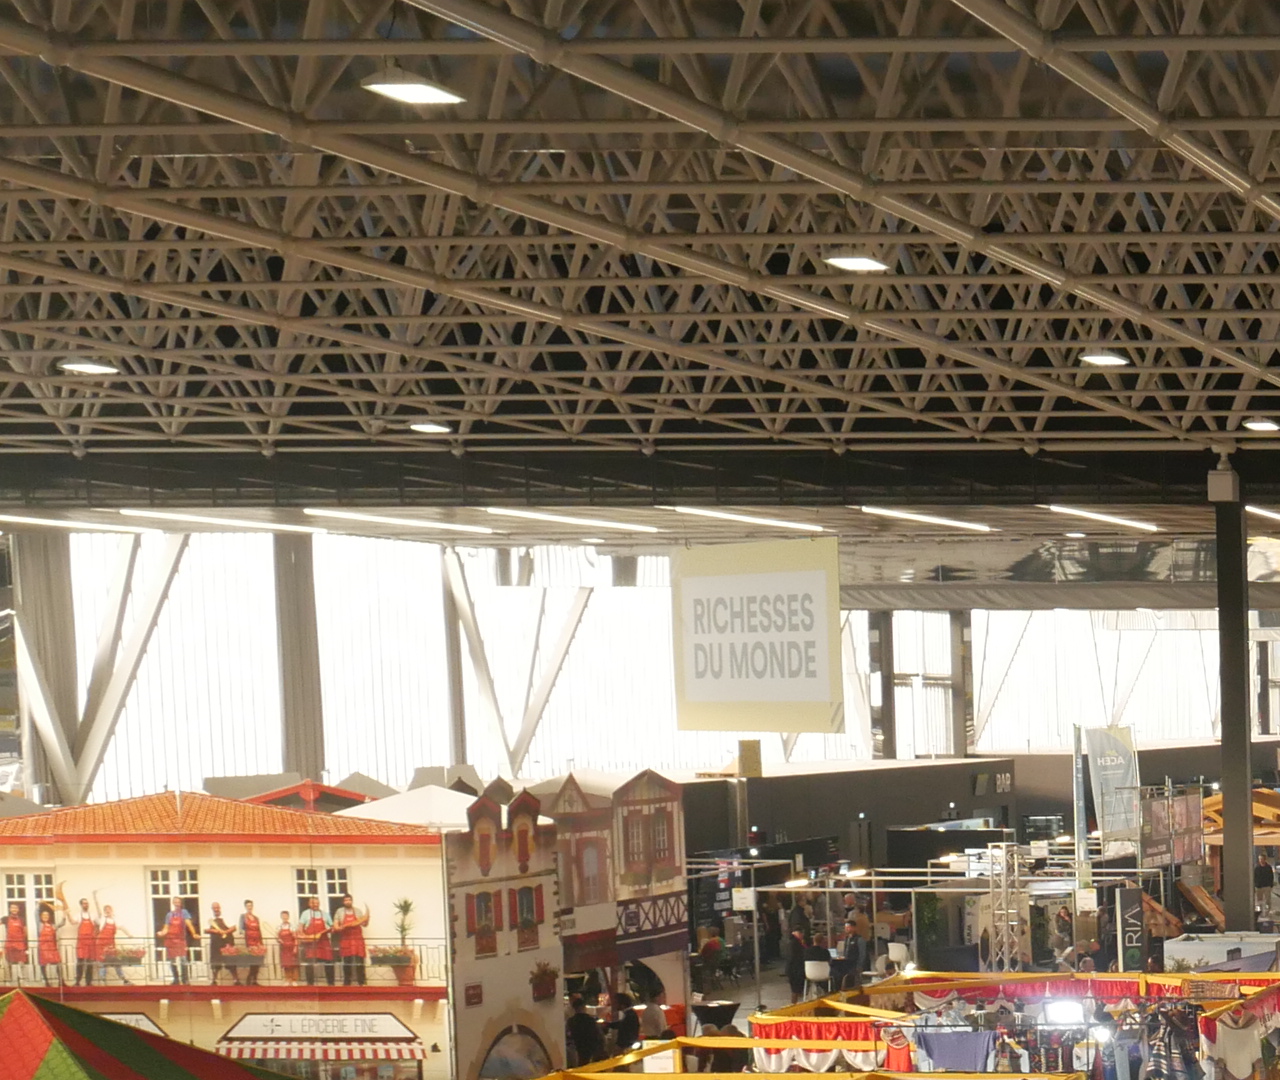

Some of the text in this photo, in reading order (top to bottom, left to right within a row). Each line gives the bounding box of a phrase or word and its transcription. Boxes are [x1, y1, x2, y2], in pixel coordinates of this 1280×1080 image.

[693, 593, 815, 634] RICHESSES
[694, 640, 817, 680] DU MONDE
[353, 1017, 379, 1034] FINE
